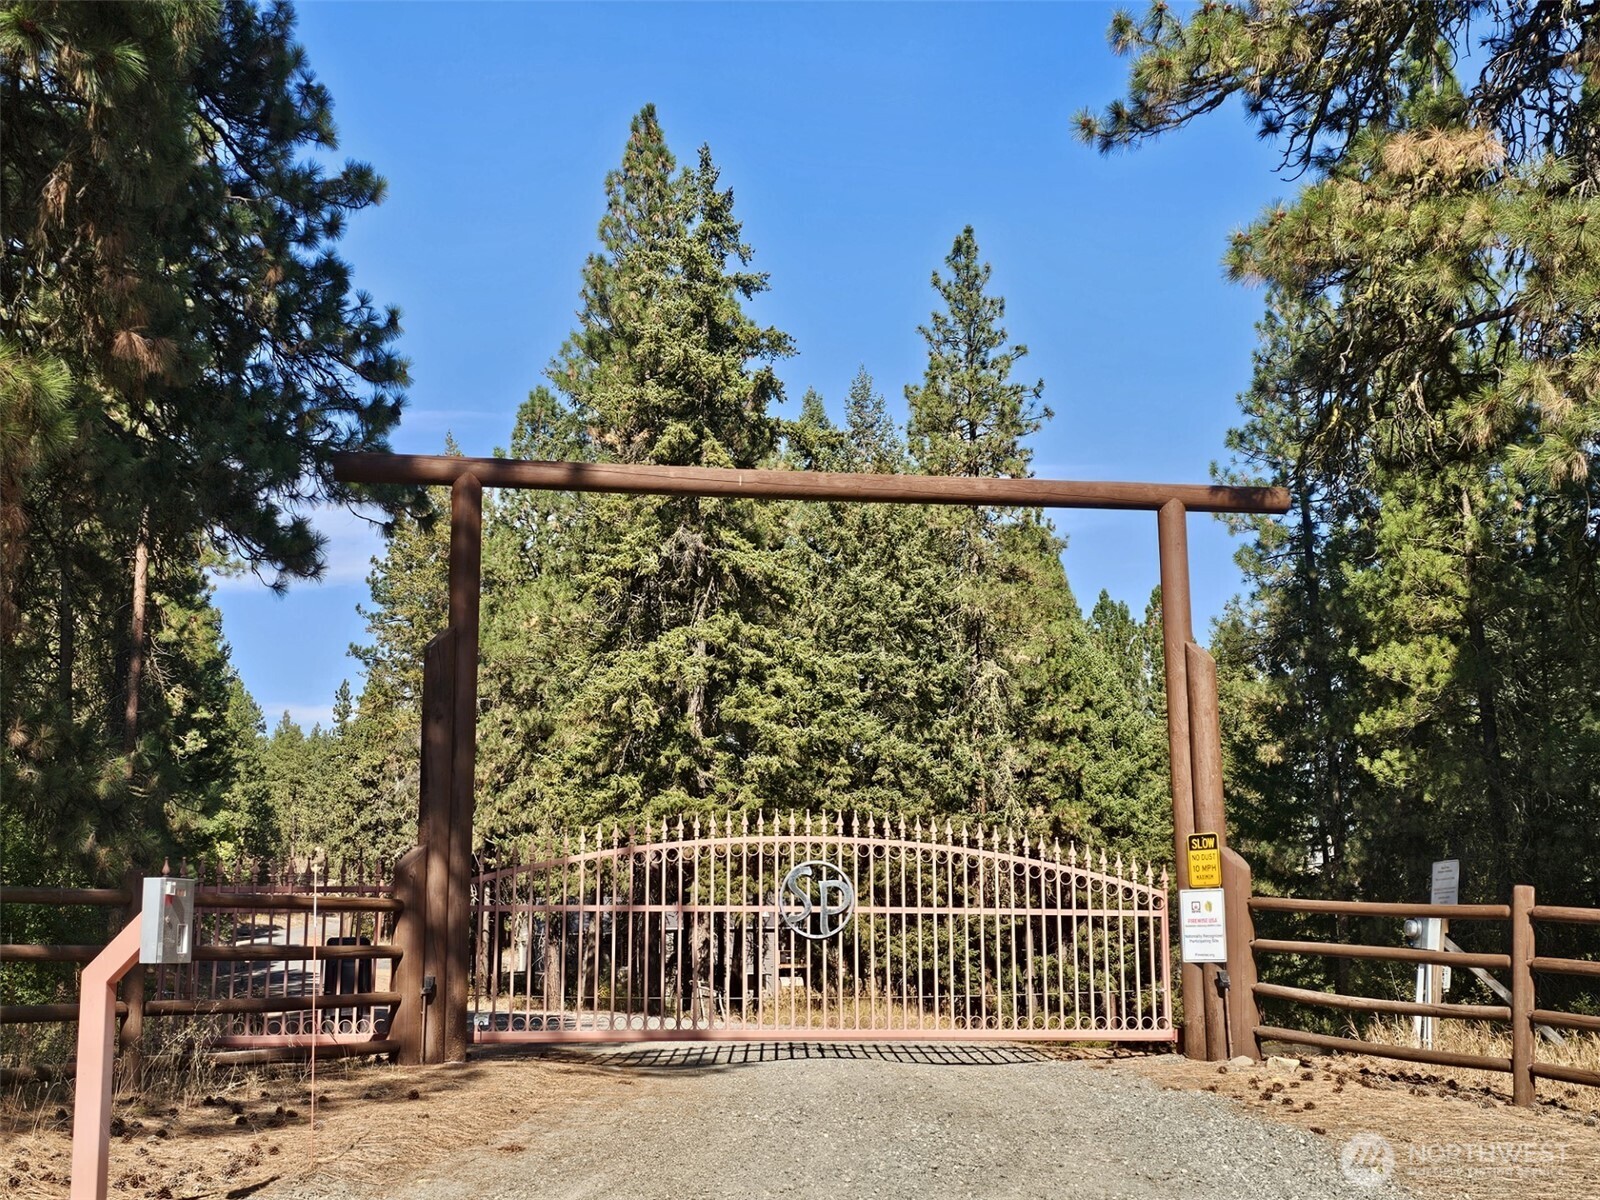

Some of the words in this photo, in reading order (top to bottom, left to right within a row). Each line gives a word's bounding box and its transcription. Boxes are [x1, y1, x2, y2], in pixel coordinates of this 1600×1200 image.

[1191, 837, 1215, 850] SLOW
[1191, 853, 1200, 861] NO
[1201, 853, 1216, 861] DUST
[1192, 864, 1200, 872] 10
[1201, 864, 1217, 872] MPH
